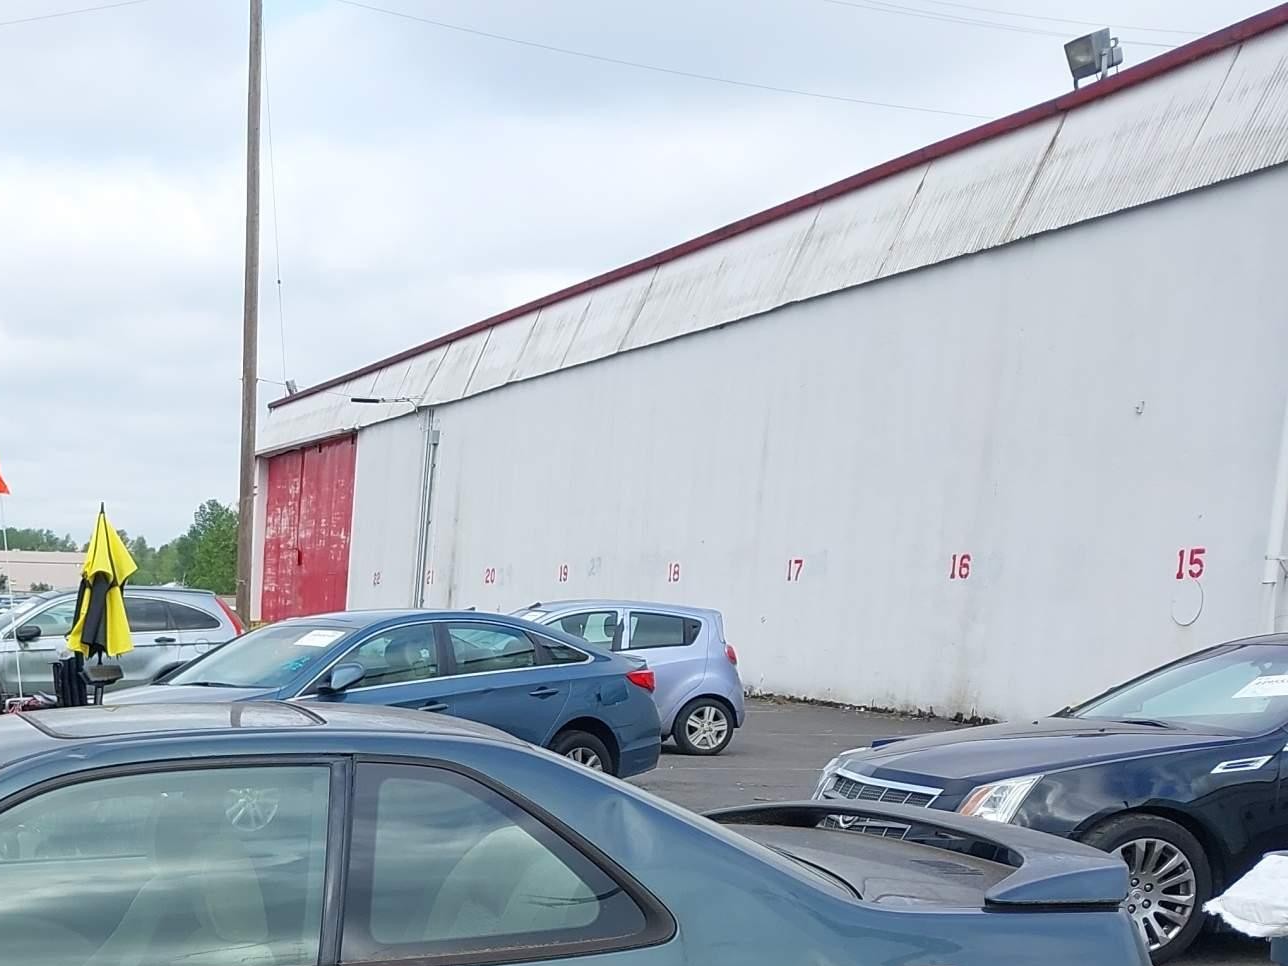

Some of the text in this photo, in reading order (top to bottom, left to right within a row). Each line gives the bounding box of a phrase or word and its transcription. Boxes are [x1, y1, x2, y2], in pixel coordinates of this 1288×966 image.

[558, 564, 569, 582] 19
[668, 563, 680, 582] 18
[787, 559, 804, 582] 17
[949, 553, 972, 579] 16
[1175, 547, 1206, 580] 15
[484, 567, 496, 584] 20
